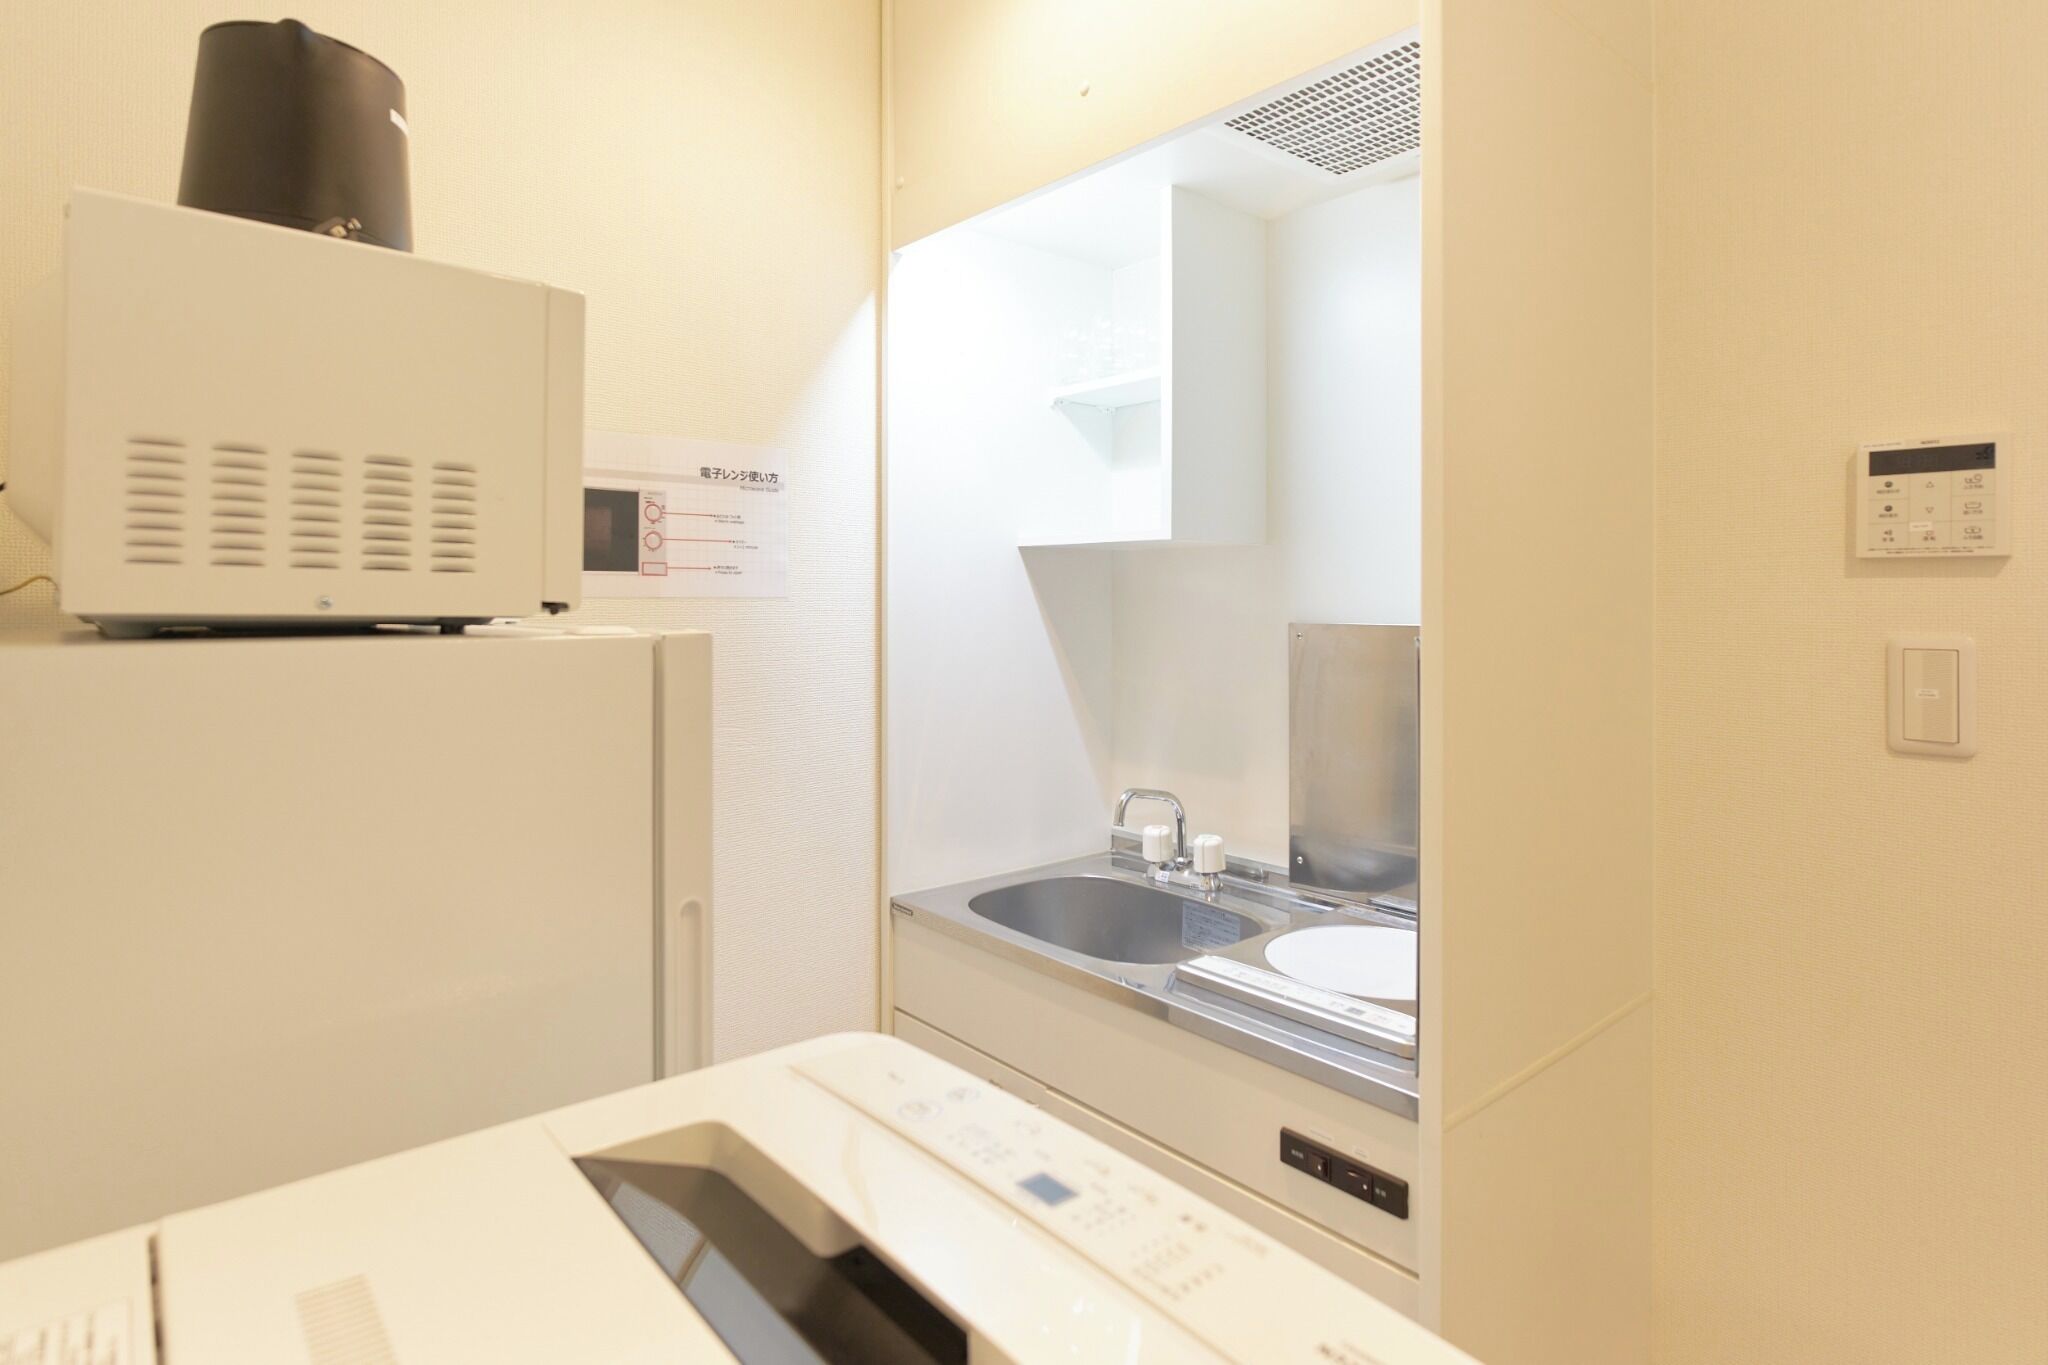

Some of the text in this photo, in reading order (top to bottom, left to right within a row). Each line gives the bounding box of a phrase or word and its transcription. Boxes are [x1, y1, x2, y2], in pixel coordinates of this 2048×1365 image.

[700, 467, 779, 483] 電子レンジ使い方
